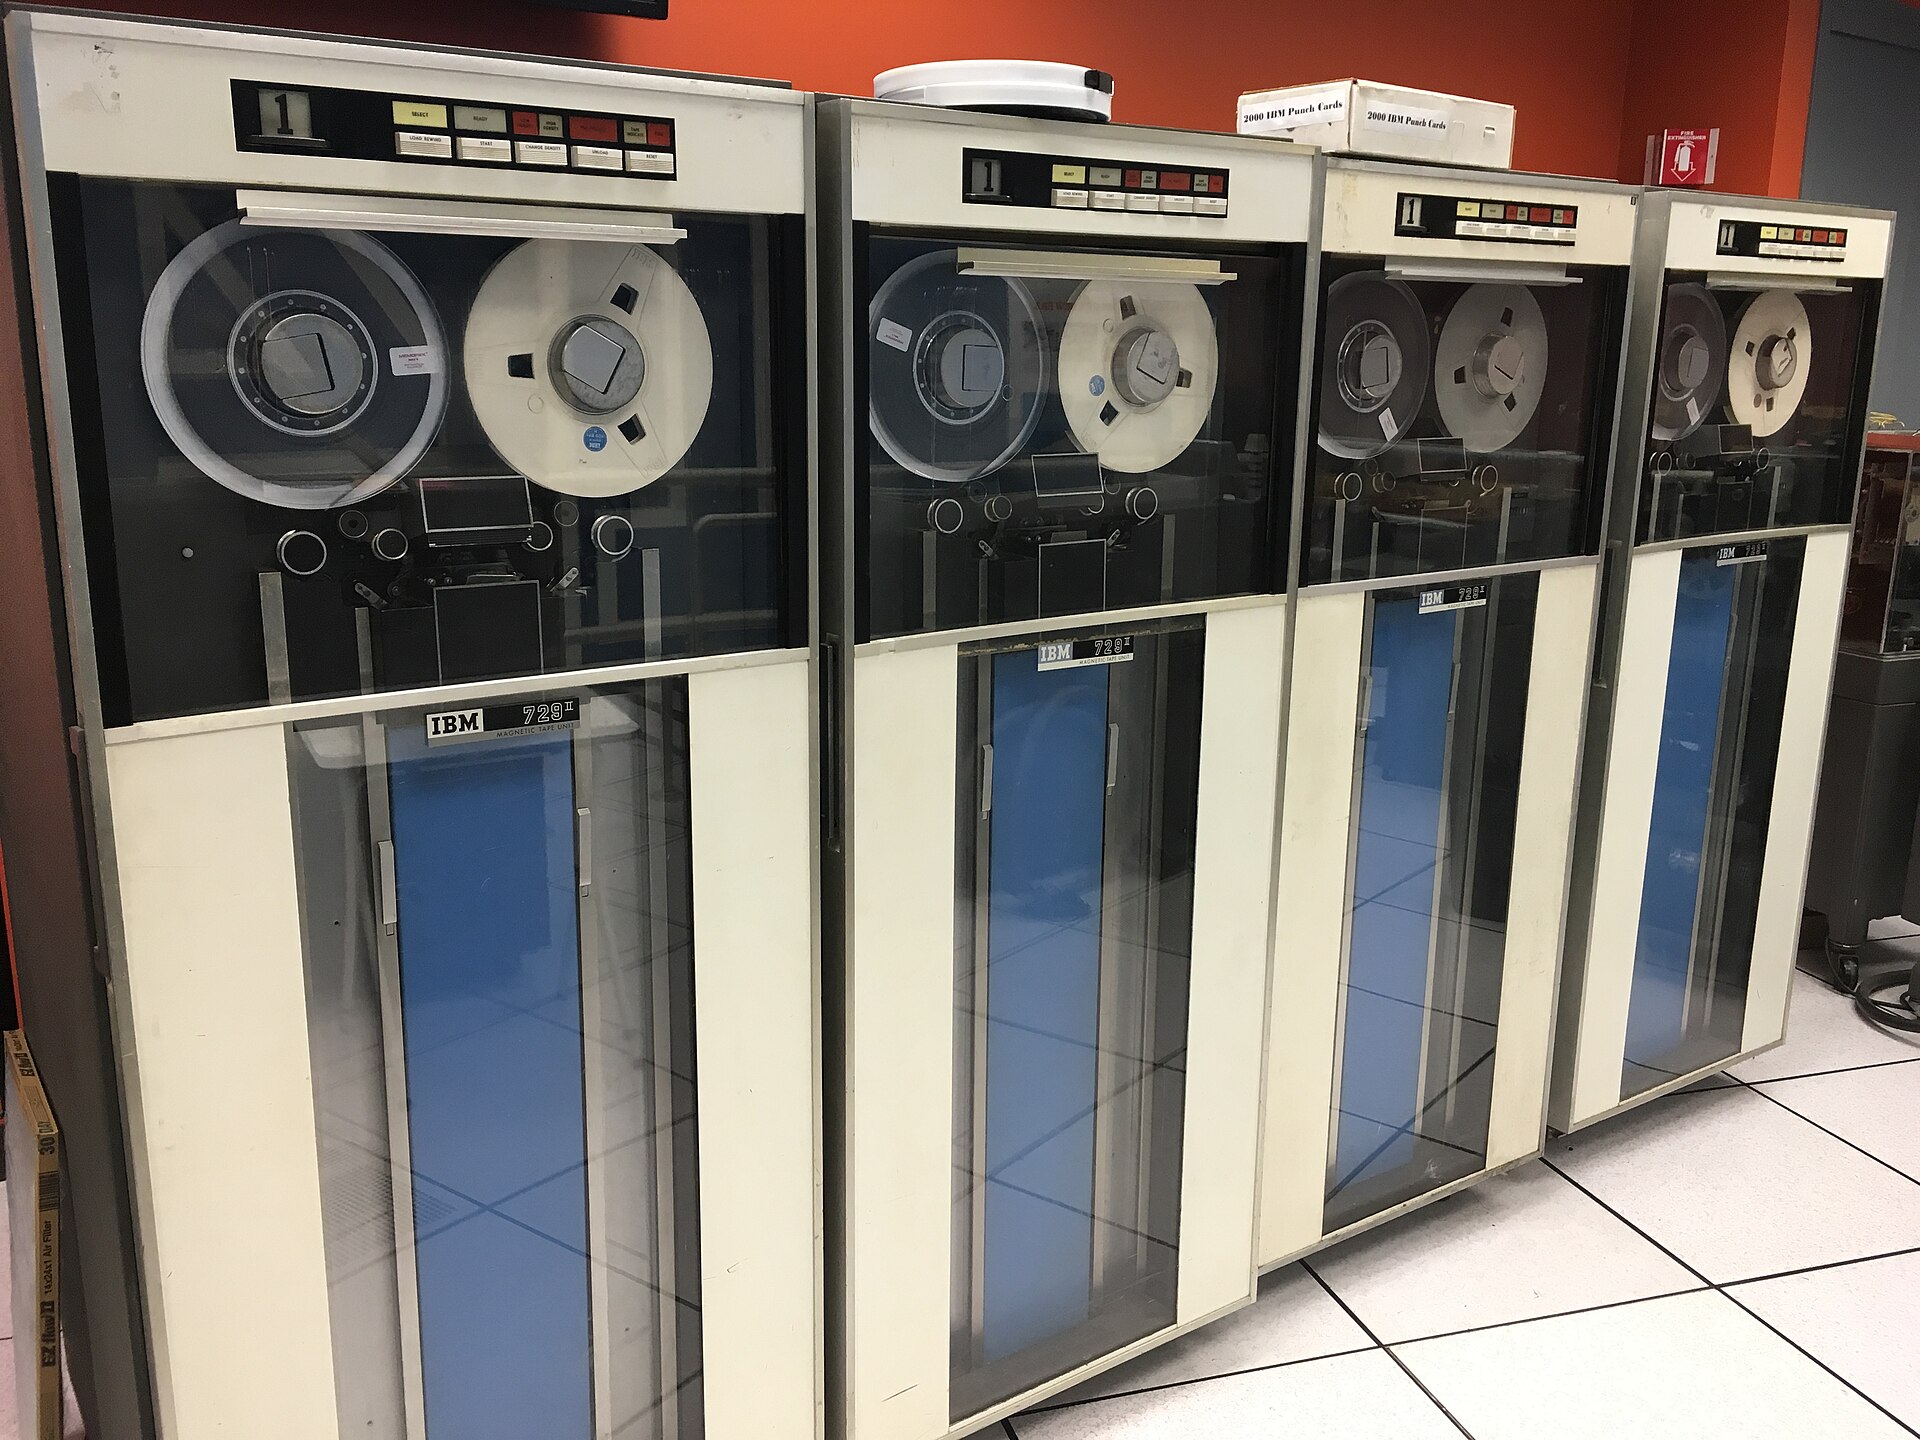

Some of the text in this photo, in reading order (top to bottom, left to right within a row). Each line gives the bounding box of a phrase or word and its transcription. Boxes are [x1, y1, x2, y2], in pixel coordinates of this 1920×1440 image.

[275, 94, 293, 135] 1
[1243, 100, 1343, 123] 2000 IBM Punch Cards
[1367, 110, 1446, 130] 2000 IBM Punch Cards
[984, 161, 994, 192] 1
[1407, 199, 1415, 224] 1
[1719, 547, 1736, 559] IBM
[1421, 591, 1443, 607] IBM
[1040, 643, 1071, 662] IBM
[1094, 638, 1123, 656] 729
[431, 712, 479, 735] IBM
[496, 722, 574, 738] MAGNETIC TAPE UNIT
[38, 1121, 55, 1155] 30 DAY
[42, 1220, 53, 1294] 14x24x1 Air Filter
[41, 1345, 56, 1367] EZ
